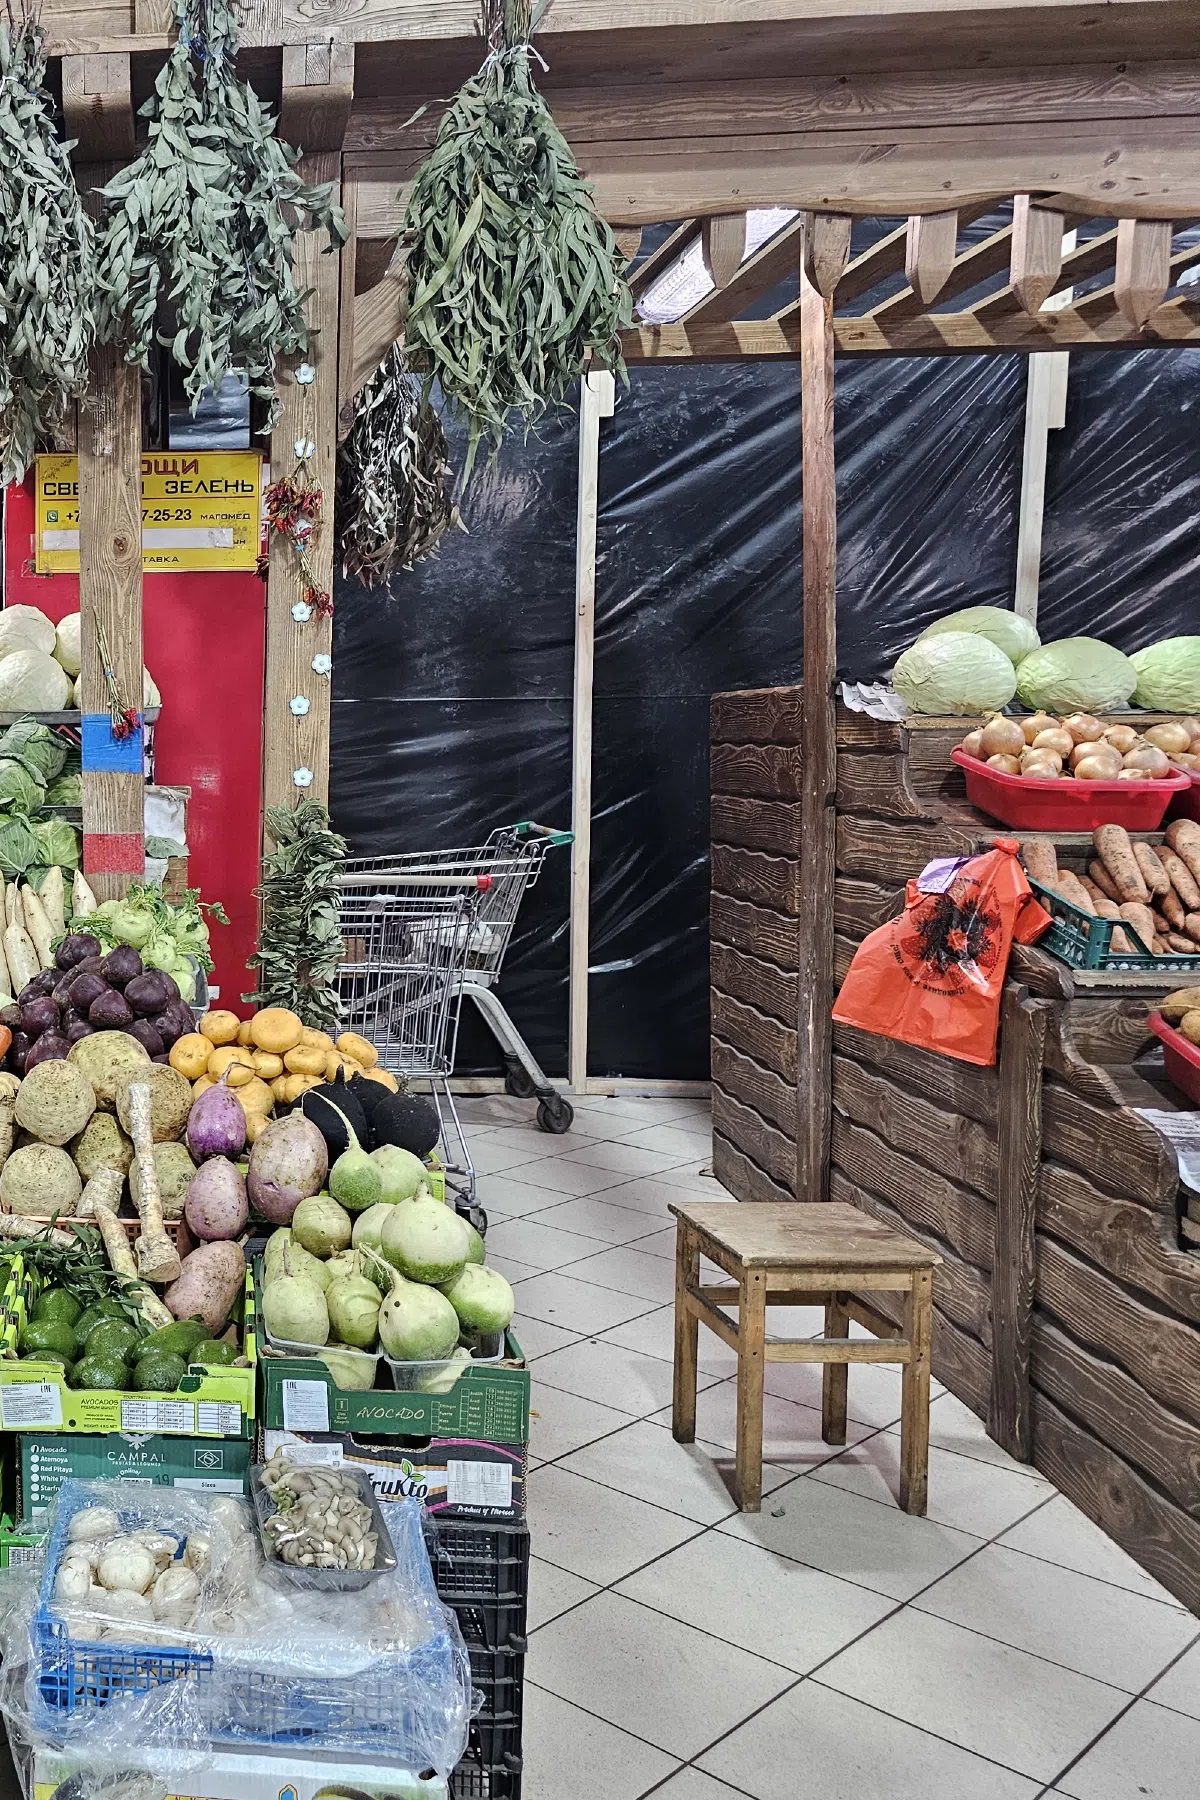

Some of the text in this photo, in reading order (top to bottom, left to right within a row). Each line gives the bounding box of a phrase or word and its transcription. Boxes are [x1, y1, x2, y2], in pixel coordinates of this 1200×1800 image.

[141, 458, 199, 477] ОЩИ
[165, 479, 254, 495] ЗЕЛЕНЬ
[142, 508, 192, 522] 7-25-23
[200, 511, 251, 520] МАГОМЕД
[142, 556, 180, 564] ТАВКА
[80, 1398, 119, 1406] AVOCADOS
[356, 1406, 425, 1420] AVOCADO
[40, 1456, 68, 1464] Atemoya
[107, 1451, 167, 1462] CAMPAL
[155, 1473, 170, 1486] 19
[40, 1494, 53, 1502] Pap
[457, 1505, 515, 1516] Product of Morocco
